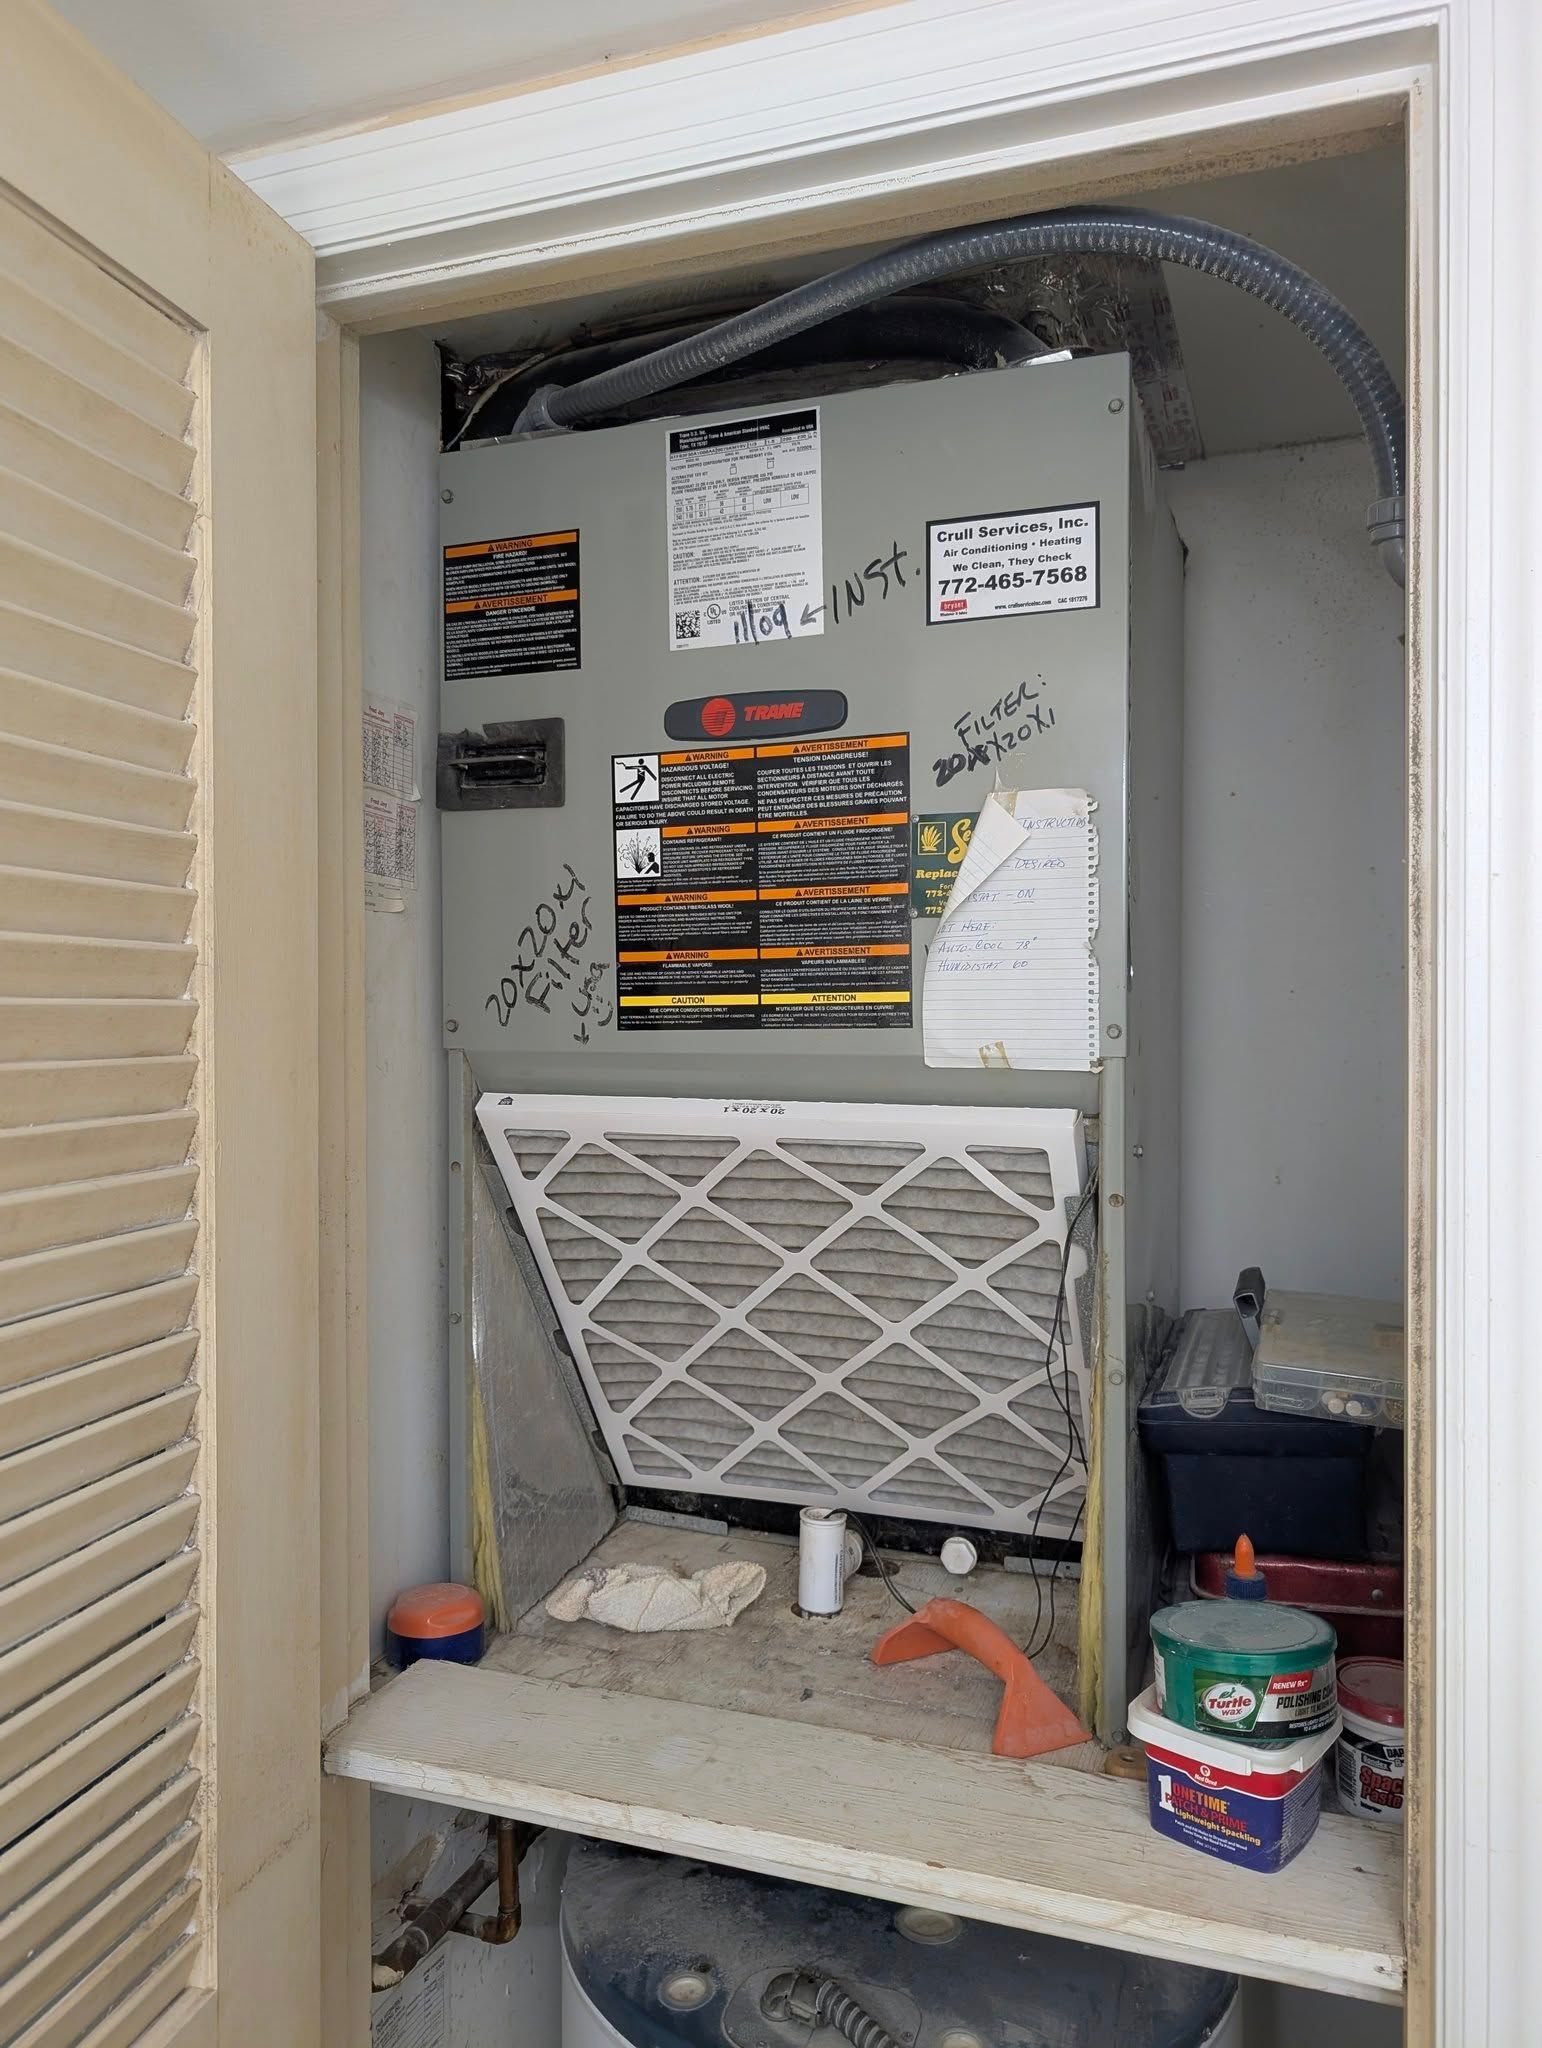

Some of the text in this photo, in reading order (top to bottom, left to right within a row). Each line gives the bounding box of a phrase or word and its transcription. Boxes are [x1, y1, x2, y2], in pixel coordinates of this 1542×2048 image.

[937, 517, 1088, 543] Crull Services, Inc.
[495, 540, 533, 551] WARNING
[943, 536, 1082, 558] Air Conditioning Heating
[953, 552, 1072, 572] We Clean, They Check
[674, 577, 701, 585] ATTENTION:
[938, 566, 1087, 596] 772-465-7568
[482, 594, 548, 608] AVERTISSEMENT
[744, 701, 804, 721] TRANE
[801, 740, 868, 753] AVERTISSEMENT
[693, 752, 729, 761] WARNING
[793, 752, 868, 763] TENSION DANGEREUSE!
[661, 765, 698, 773] HAZARDOUS
[802, 817, 869, 828] AVERTISSEMENT
[695, 826, 730, 834] WARNING
[916, 870, 959, 879] Replac
[672, 894, 707, 902] WARNING
[803, 887, 870, 896] AVERTISSEMENT
[525, 897, 592, 1014] Filter
[805, 947, 871, 955] AVERTISSEMENT
[1209, 1696, 1252, 1709] Turtle
[1276, 1689, 1322, 1709] POLISHING
[1195, 1774, 1205, 1782] Red
[1173, 1781, 1228, 1814] ONETIME
[1361, 1784, 1403, 1809] Paste
[1165, 1792, 1199, 1813] PATCH
[1211, 1812, 1247, 1832] PRIME
[1176, 1808, 1220, 1830] Lightweight
[1221, 1826, 1261, 1846] Spackling
